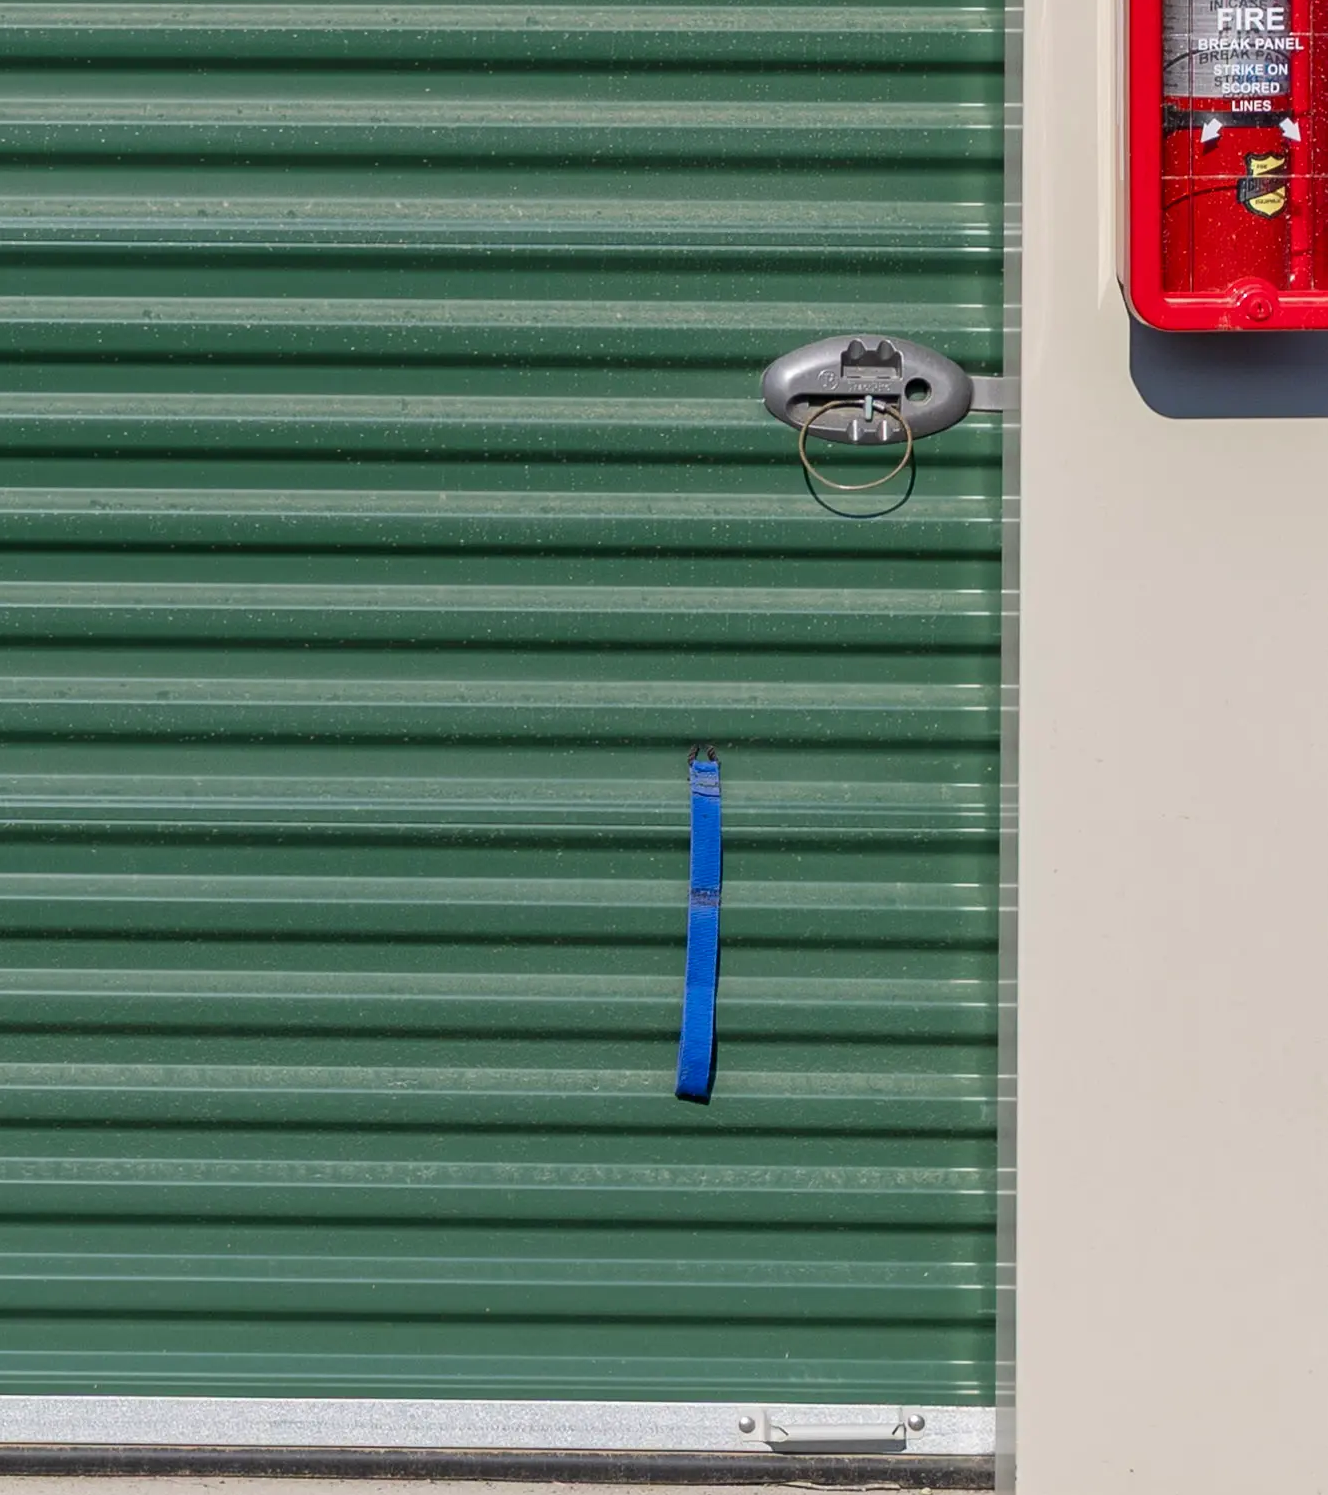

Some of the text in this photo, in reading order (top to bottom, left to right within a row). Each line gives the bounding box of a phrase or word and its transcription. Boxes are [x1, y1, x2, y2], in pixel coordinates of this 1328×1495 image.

[1217, 7, 1285, 31] FIRE
[1198, 38, 1304, 50] BREAK PANEL
[1213, 63, 1288, 76] STRIKE ON
[1222, 81, 1280, 94] SCORED
[1231, 100, 1272, 112] LINES
